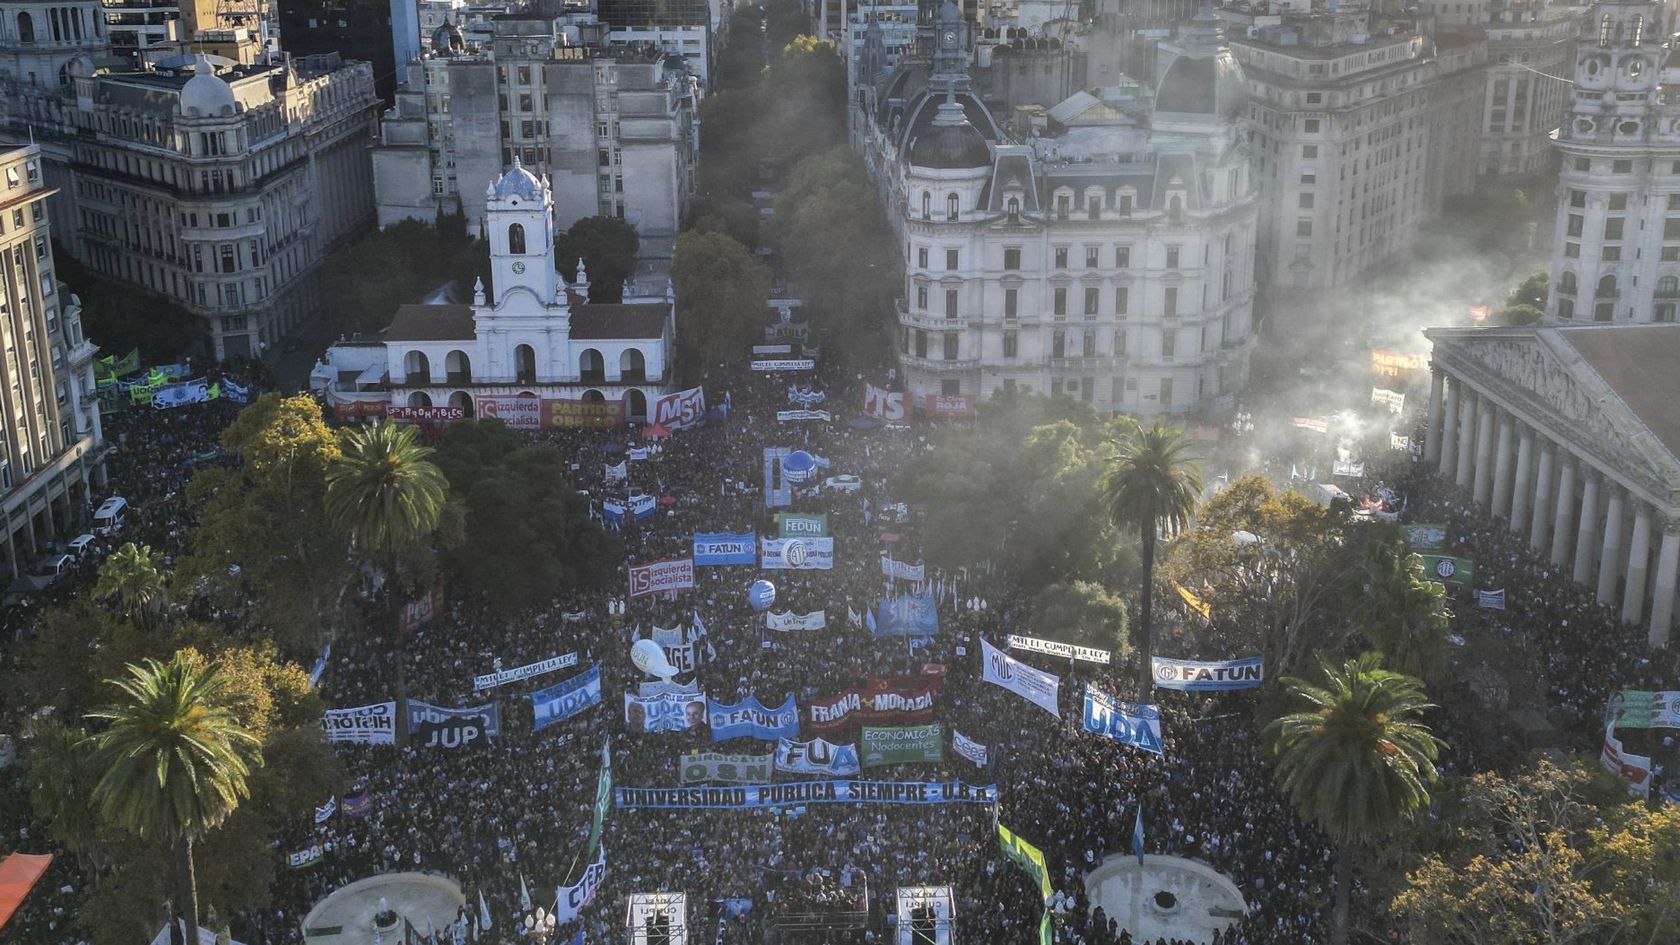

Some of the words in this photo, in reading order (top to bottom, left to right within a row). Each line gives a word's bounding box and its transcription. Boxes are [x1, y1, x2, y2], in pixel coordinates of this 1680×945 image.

[497, 402, 539, 413] izquierda
[551, 402, 619, 415] PARTIDO
[865, 382, 904, 420] PTS
[500, 417, 539, 426] ocialista
[785, 518, 821, 532] FEDUN
[709, 544, 741, 554] FATUN
[651, 563, 691, 577] izquierda
[651, 573, 691, 586] socialista
[1044, 642, 1074, 655] CUMPL
[1182, 665, 1260, 681] FATUN
[548, 688, 591, 718] UDA
[811, 694, 860, 722] FRANJA
[875, 691, 932, 711] MORADA
[729, 712, 779, 728] FATUN
[1084, 697, 1163, 754] UDA
[425, 726, 479, 748] JUP
[687, 753, 767, 763] SINDICATO
[785, 738, 858, 772] FUA
[622, 788, 745, 806] UNIVERSIDAD
[849, 782, 927, 801] SIEMPRE
